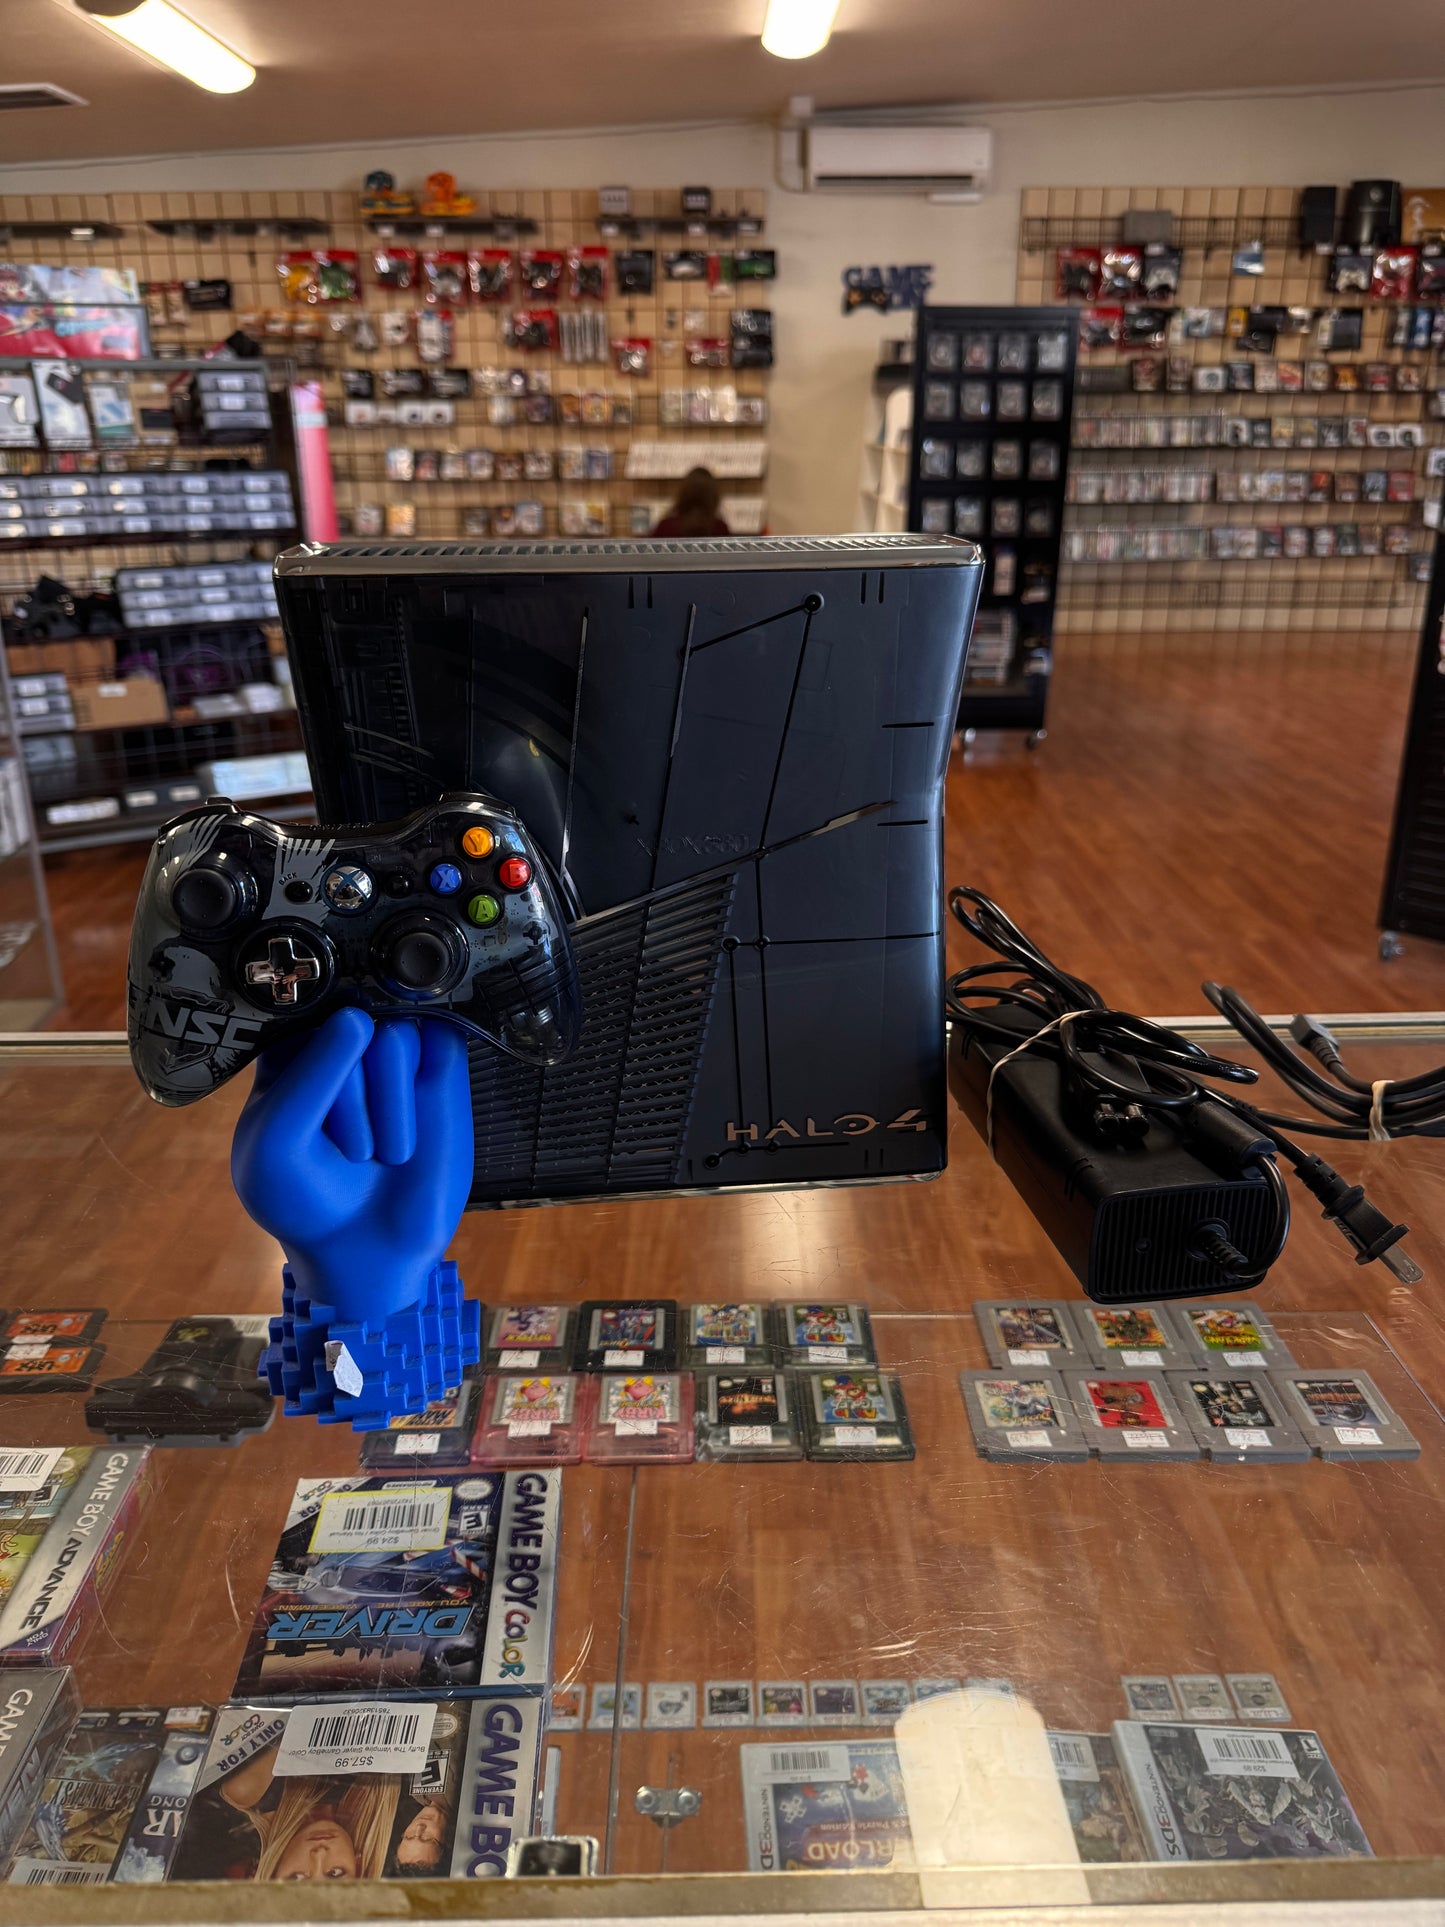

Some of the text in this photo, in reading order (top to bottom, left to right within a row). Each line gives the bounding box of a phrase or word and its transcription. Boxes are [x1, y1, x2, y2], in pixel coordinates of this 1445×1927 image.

[843, 264, 933, 290] GAME
[278, 871, 298, 886] BACK
[437, 869, 457, 889] X
[475, 900, 495, 920] A
[143, 998, 263, 1052] NSC
[727, 1108, 928, 1142] HALO 4
[506, 1407, 560, 1420] KIRBY
[612, 1406, 666, 1420] KIRBY
[89, 1452, 129, 1500] GAME
[300, 1501, 322, 1518] FOR
[68, 1504, 104, 1537] BOY
[462, 1512, 482, 1529] E
[366, 1536, 400, 1545] $24.99
[18, 1537, 82, 1631] ADVANCE
[498, 1472, 549, 1679] GAME BOY COLOR
[266, 1605, 475, 1640] DRIVER
[26, 1631, 44, 1643] FOR
[27, 1632, 48, 1647] ONLY
[0, 1688, 34, 1757] GAM
[220, 1713, 261, 1746] COLOR
[216, 1719, 285, 1772] ONLY FOR
[307, 1747, 341, 1756] GameBoy
[341, 1746, 363, 1755] Slayer
[364, 1746, 392, 1755] Vampire
[408, 1745, 426, 1753] Buffy
[334, 1755, 374, 1768] $57.99
[420, 1759, 442, 1786] E
[411, 1786, 444, 1794] EVERYONE
[466, 1704, 523, 1878] GAME BO
[150, 1795, 188, 1807] ONG
[758, 1788, 775, 1871] NINTENDO3D
[807, 1837, 909, 1861] ERLOAD
